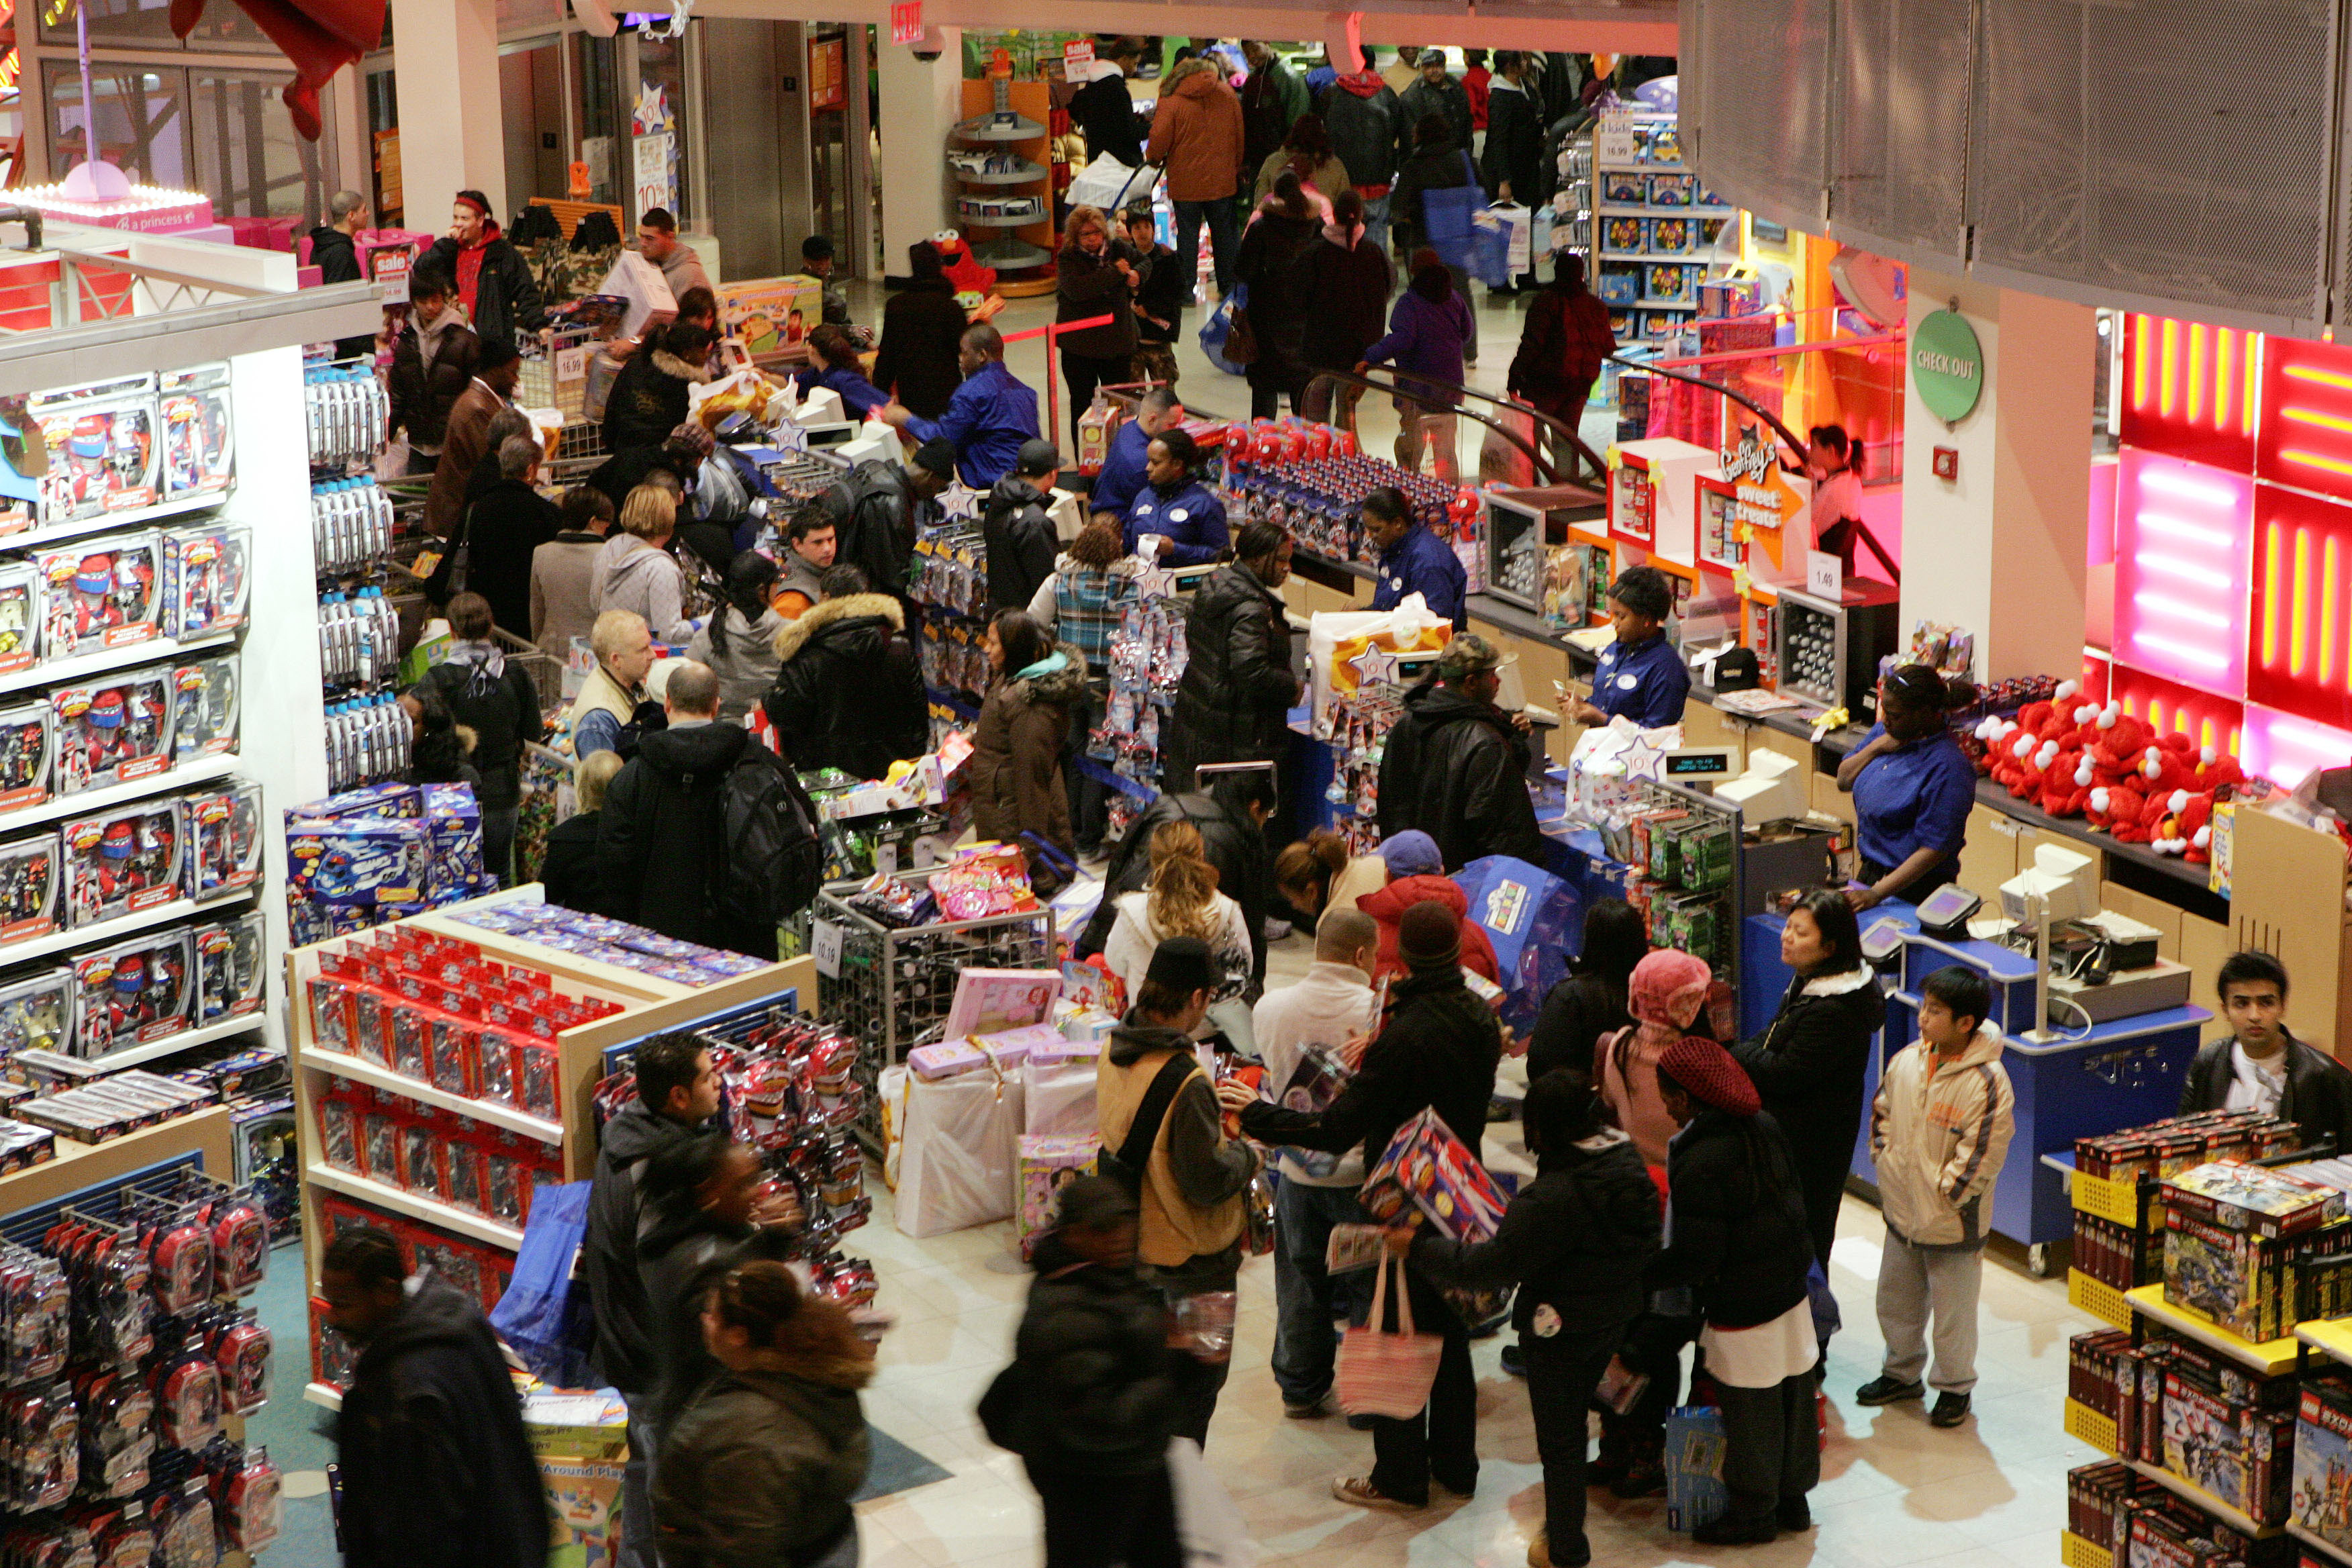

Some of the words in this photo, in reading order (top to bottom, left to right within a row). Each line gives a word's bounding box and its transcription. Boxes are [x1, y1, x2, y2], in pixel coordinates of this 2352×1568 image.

[897, 1, 921, 42] EXIT
[1066, 40, 1092, 56] sale
[132, 221, 138, 230] a
[140, 214, 183, 231] princess
[377, 255, 405, 273] sale
[1916, 349, 1950, 375] CHECK
[1951, 357, 1975, 381] OUT
[1720, 440, 1775, 484] Geoffrey's
[1736, 485, 1781, 509] sweet
[1736, 501, 1781, 529] treats
[1816, 571, 1833, 588] 1.49
[818, 942, 835, 963] 10.19
